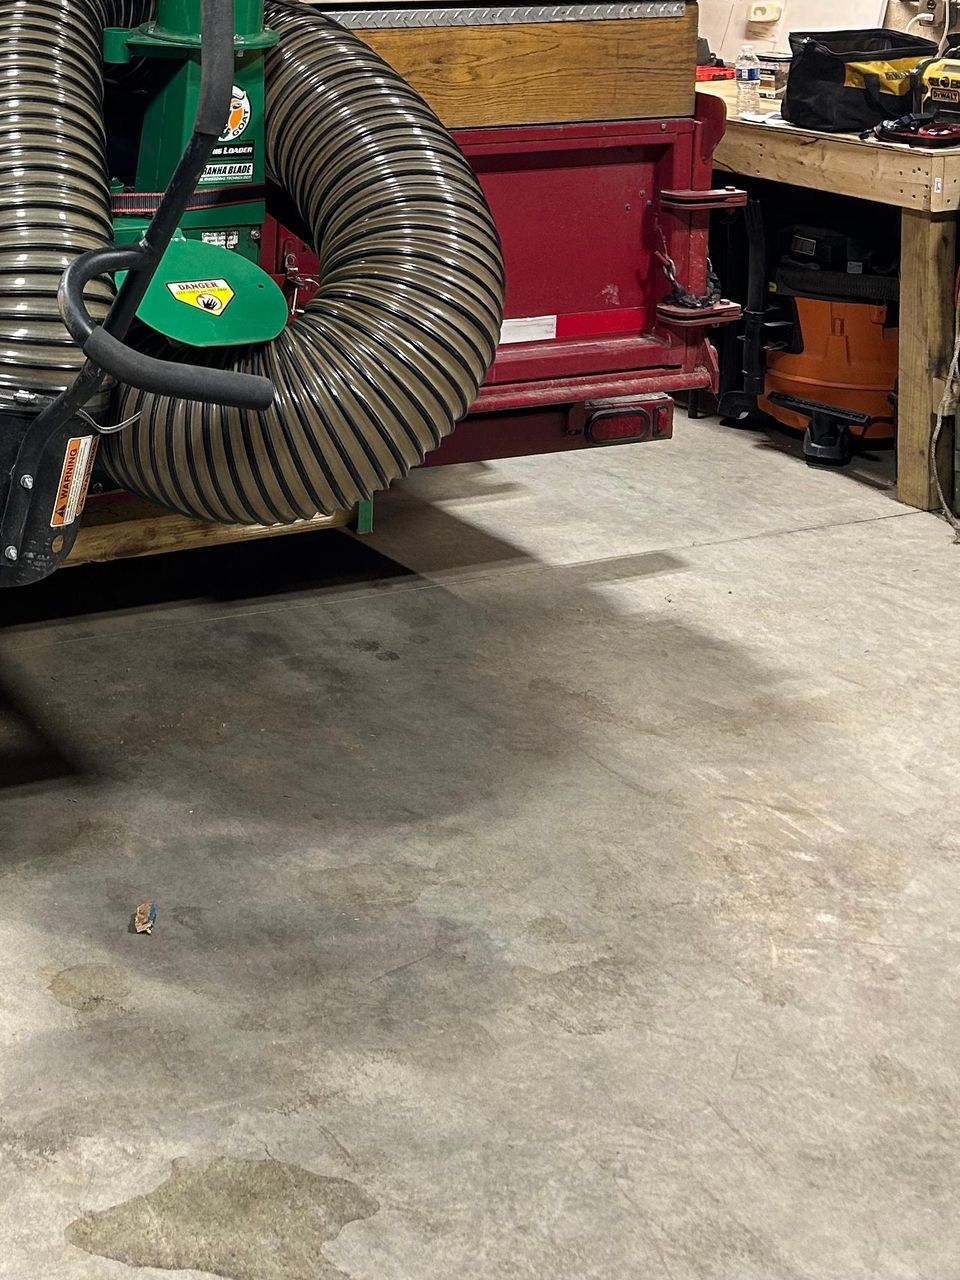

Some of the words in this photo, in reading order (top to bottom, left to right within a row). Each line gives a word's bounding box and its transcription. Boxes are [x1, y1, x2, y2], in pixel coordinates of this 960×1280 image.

[232, 109, 250, 137] GOAT
[223, 147, 253, 155] LOADER
[202, 166, 227, 176] RANHA
[227, 164, 252, 175] BLADE
[178, 282, 219, 291] DANGER
[60, 448, 79, 499] WARNING
